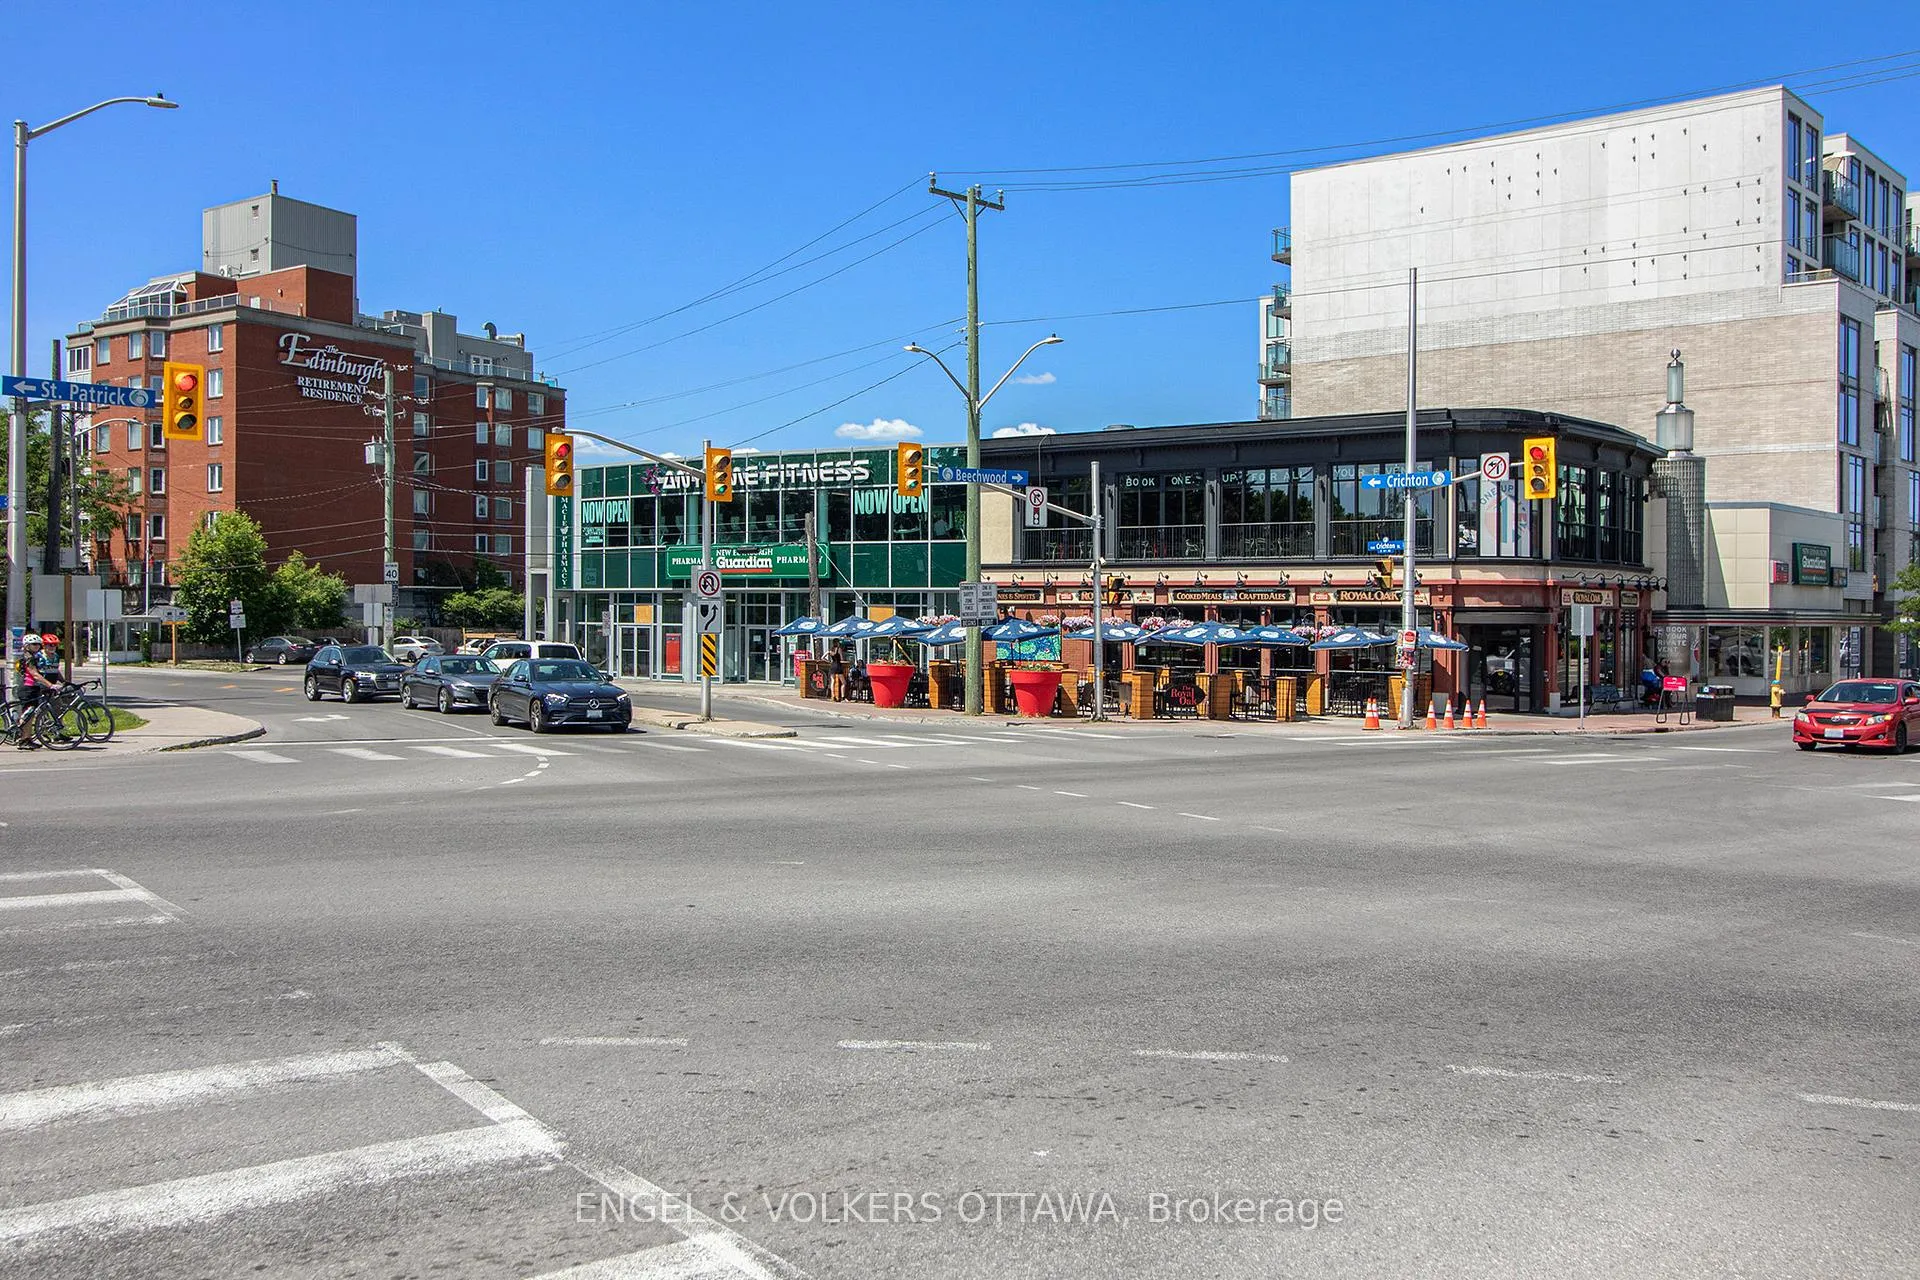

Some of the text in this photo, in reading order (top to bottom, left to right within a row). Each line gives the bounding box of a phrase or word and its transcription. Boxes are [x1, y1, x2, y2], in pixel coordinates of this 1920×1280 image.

[279, 333, 384, 384] Edinburgh
[41, 381, 125, 405] St. Patrick
[297, 376, 368, 394] RETIREMENT
[302, 387, 363, 404] RESIDENCE
[766, 459, 869, 485] FITNESS
[956, 469, 1007, 484] Beechwood
[1125, 478, 1156, 487] BOOK
[1386, 474, 1429, 487] Crichton
[854, 488, 928, 514] NOW OPEN
[582, 500, 629, 523] NOW OPEN
[561, 535, 569, 586] PHARMACY
[672, 556, 823, 569] PHARMAE Guardian PHARMY
[386, 569, 398, 579] 40
[1176, 592, 1286, 600] COOKED MEALS CRAFTED ALES
[1340, 591, 1374, 601] ROYAL
[1374, 590, 1399, 601] OAK
[1171, 687, 1194, 697] Royal
